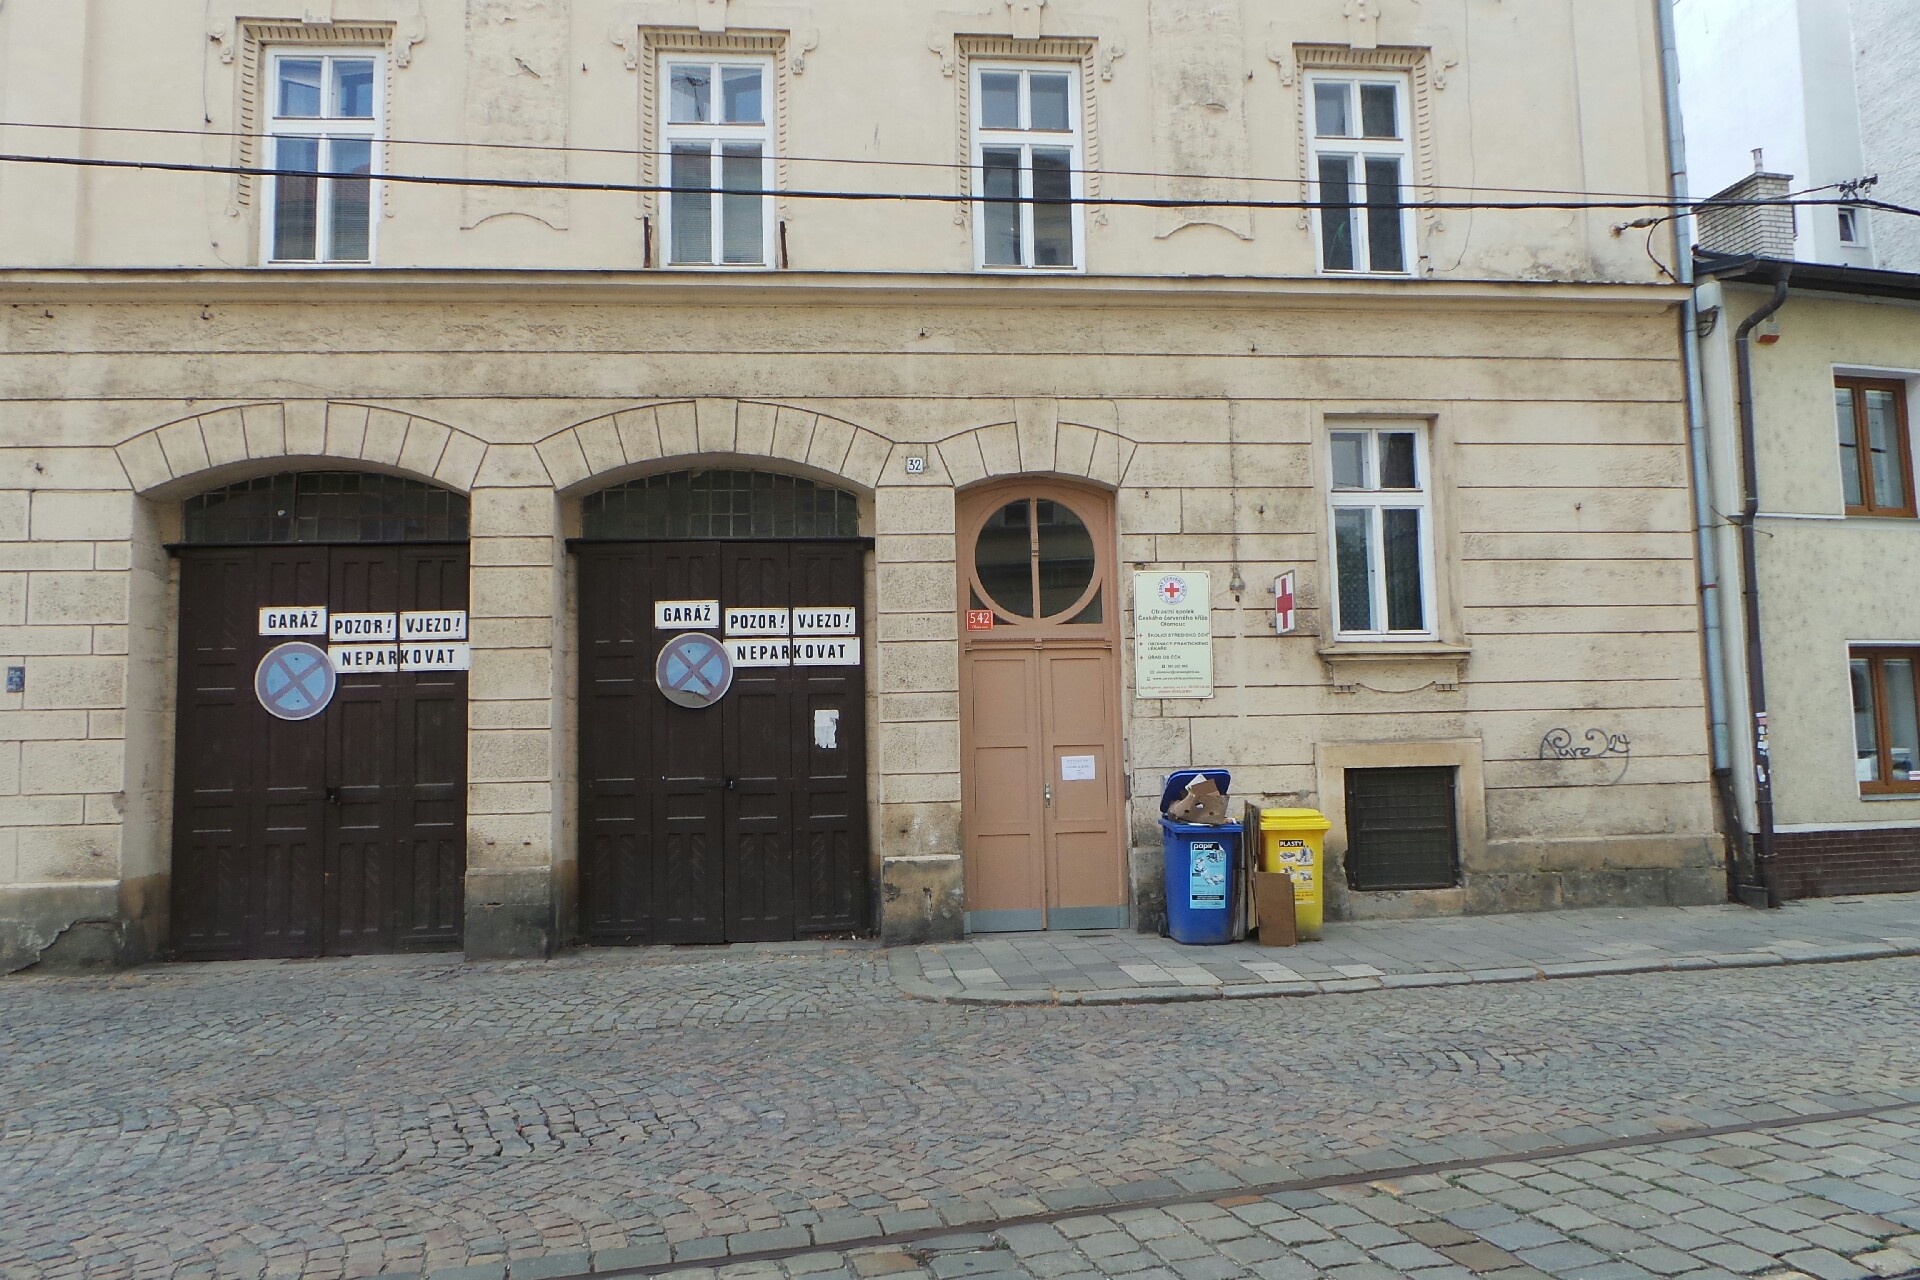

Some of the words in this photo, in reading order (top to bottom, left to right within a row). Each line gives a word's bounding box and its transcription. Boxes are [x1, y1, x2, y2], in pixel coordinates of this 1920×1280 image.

[908, 459, 922, 471] 32
[268, 610, 319, 629] GARÁŽ
[663, 604, 711, 622] GARÁŽ
[730, 614, 786, 629] POZOR!
[797, 613, 851, 629] VJEZD!
[969, 612, 990, 624] 542
[334, 618, 392, 635] POZOR!
[405, 617, 461, 633] VJEZD!
[341, 648, 455, 666] NEPARKOVAT
[736, 643, 846, 661] NEPARKOVAT
